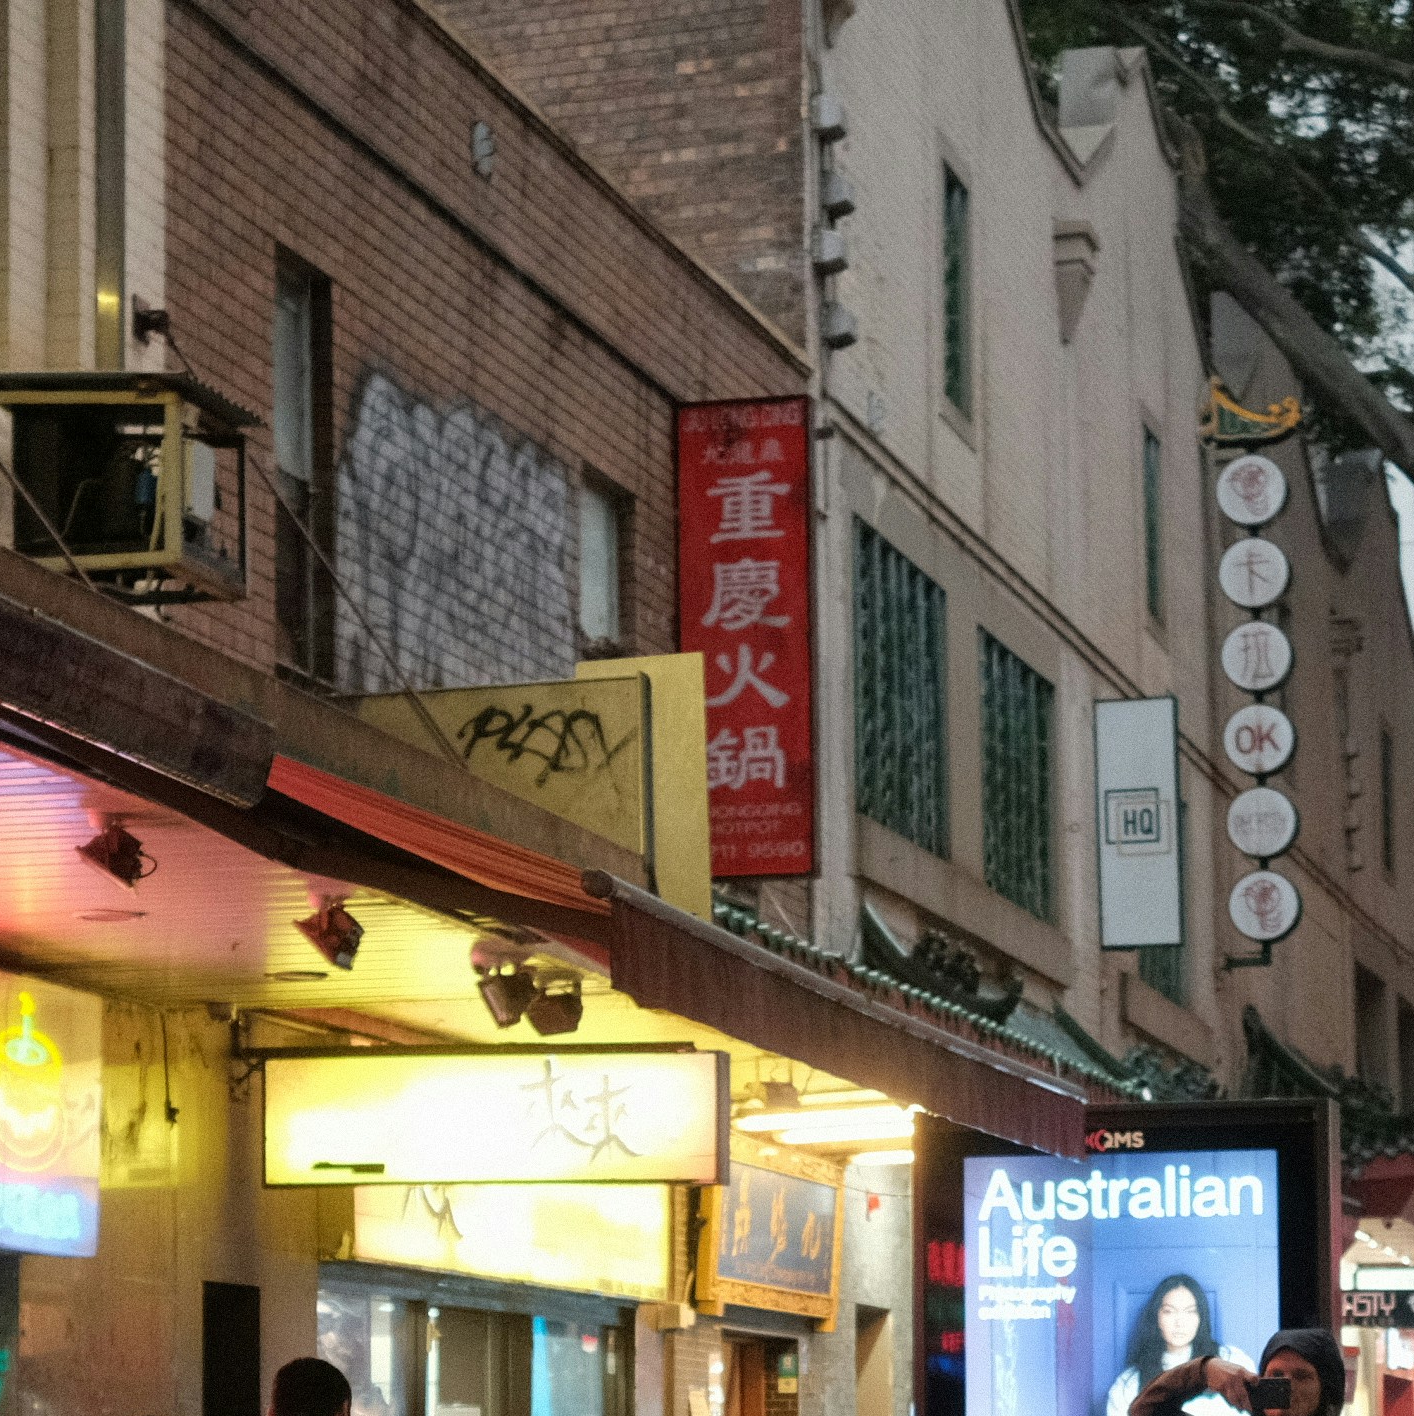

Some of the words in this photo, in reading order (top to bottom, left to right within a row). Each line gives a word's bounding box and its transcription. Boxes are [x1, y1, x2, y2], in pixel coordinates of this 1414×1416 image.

[701, 469, 792, 790] 重慶火鍋
[1122, 808, 1155, 837] HQ
[977, 1164, 1264, 1221] Australian
[977, 1223, 1078, 1278] Life
